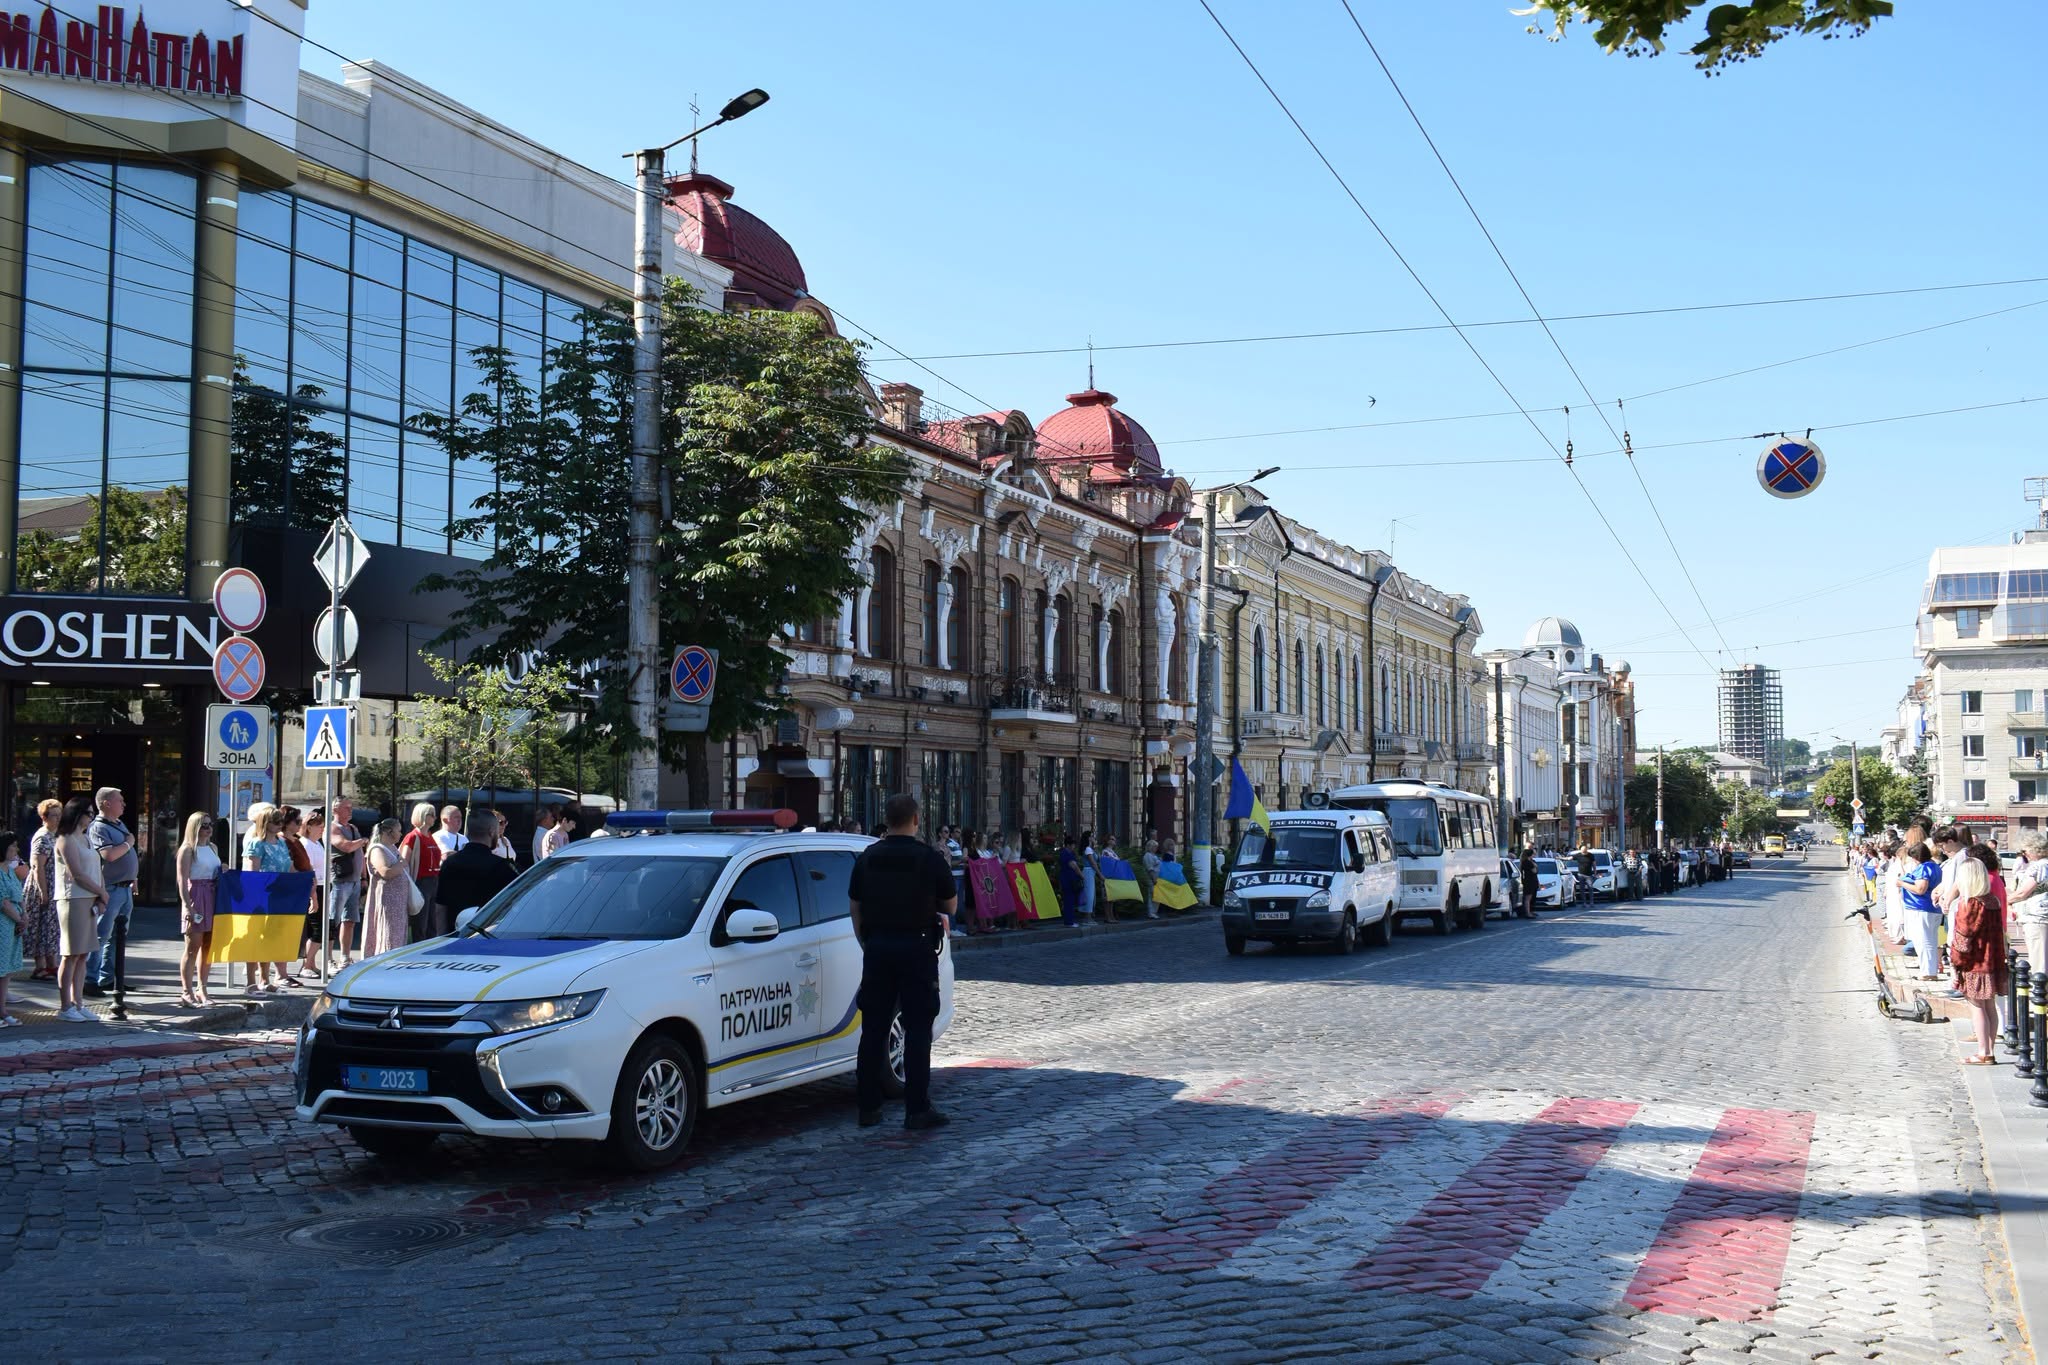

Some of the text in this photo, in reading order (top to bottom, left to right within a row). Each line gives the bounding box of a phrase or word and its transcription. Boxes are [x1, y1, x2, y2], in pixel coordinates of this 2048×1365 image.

[0, 4, 243, 96] MANHATTAN
[0, 609, 219, 664] OSHEN
[219, 752, 257, 765] ЗОНА
[1268, 873, 1325, 886] ЩИТІ
[720, 981, 792, 1011] ПАТРУЛЬНА
[721, 1003, 792, 1042] ПОЛІЦІЯ
[380, 1070, 416, 1089] 2023
